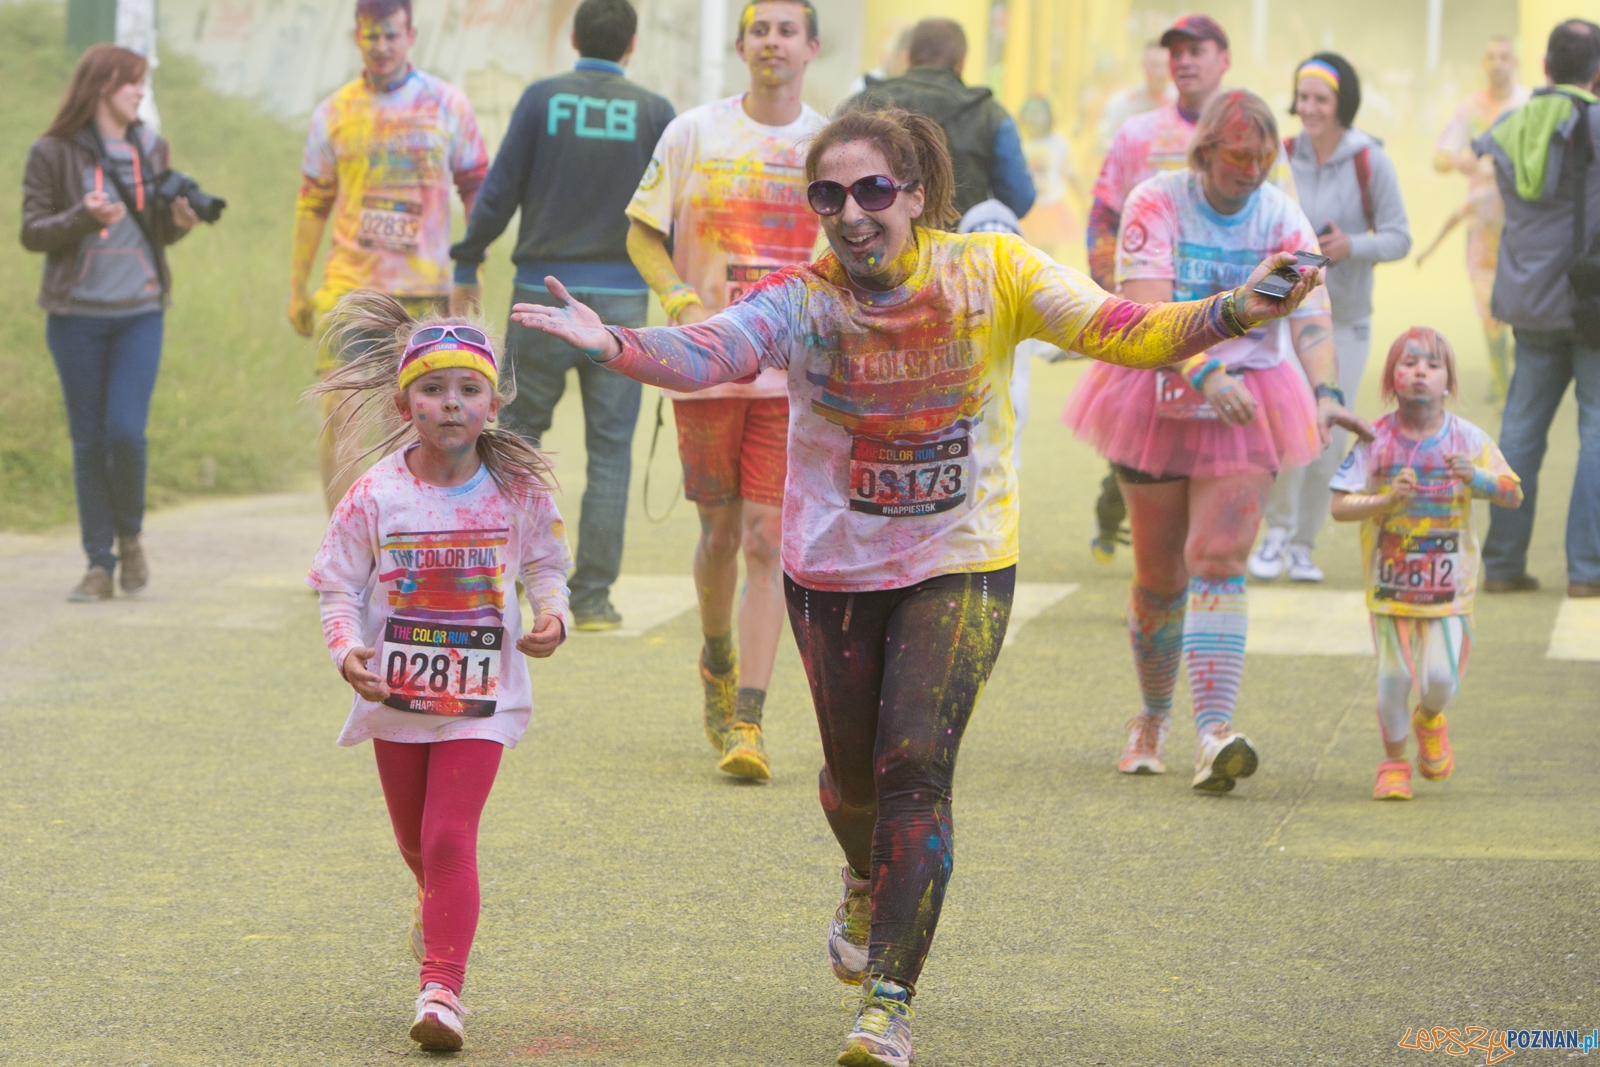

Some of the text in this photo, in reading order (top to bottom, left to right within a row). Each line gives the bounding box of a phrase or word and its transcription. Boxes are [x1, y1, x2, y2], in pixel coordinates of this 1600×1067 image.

[547, 93, 637, 142] FCB
[863, 350, 931, 382] COLOR
[879, 448, 914, 461] COLOR
[914, 448, 936, 461] RUN
[882, 502, 936, 515] #HAPPIEST5K
[389, 547, 497, 569] THE COLOR RUN
[1379, 559, 1454, 588] 02812
[393, 624, 413, 641] THE
[412, 627, 448, 644] COLOR
[387, 650, 491, 696] 02811
